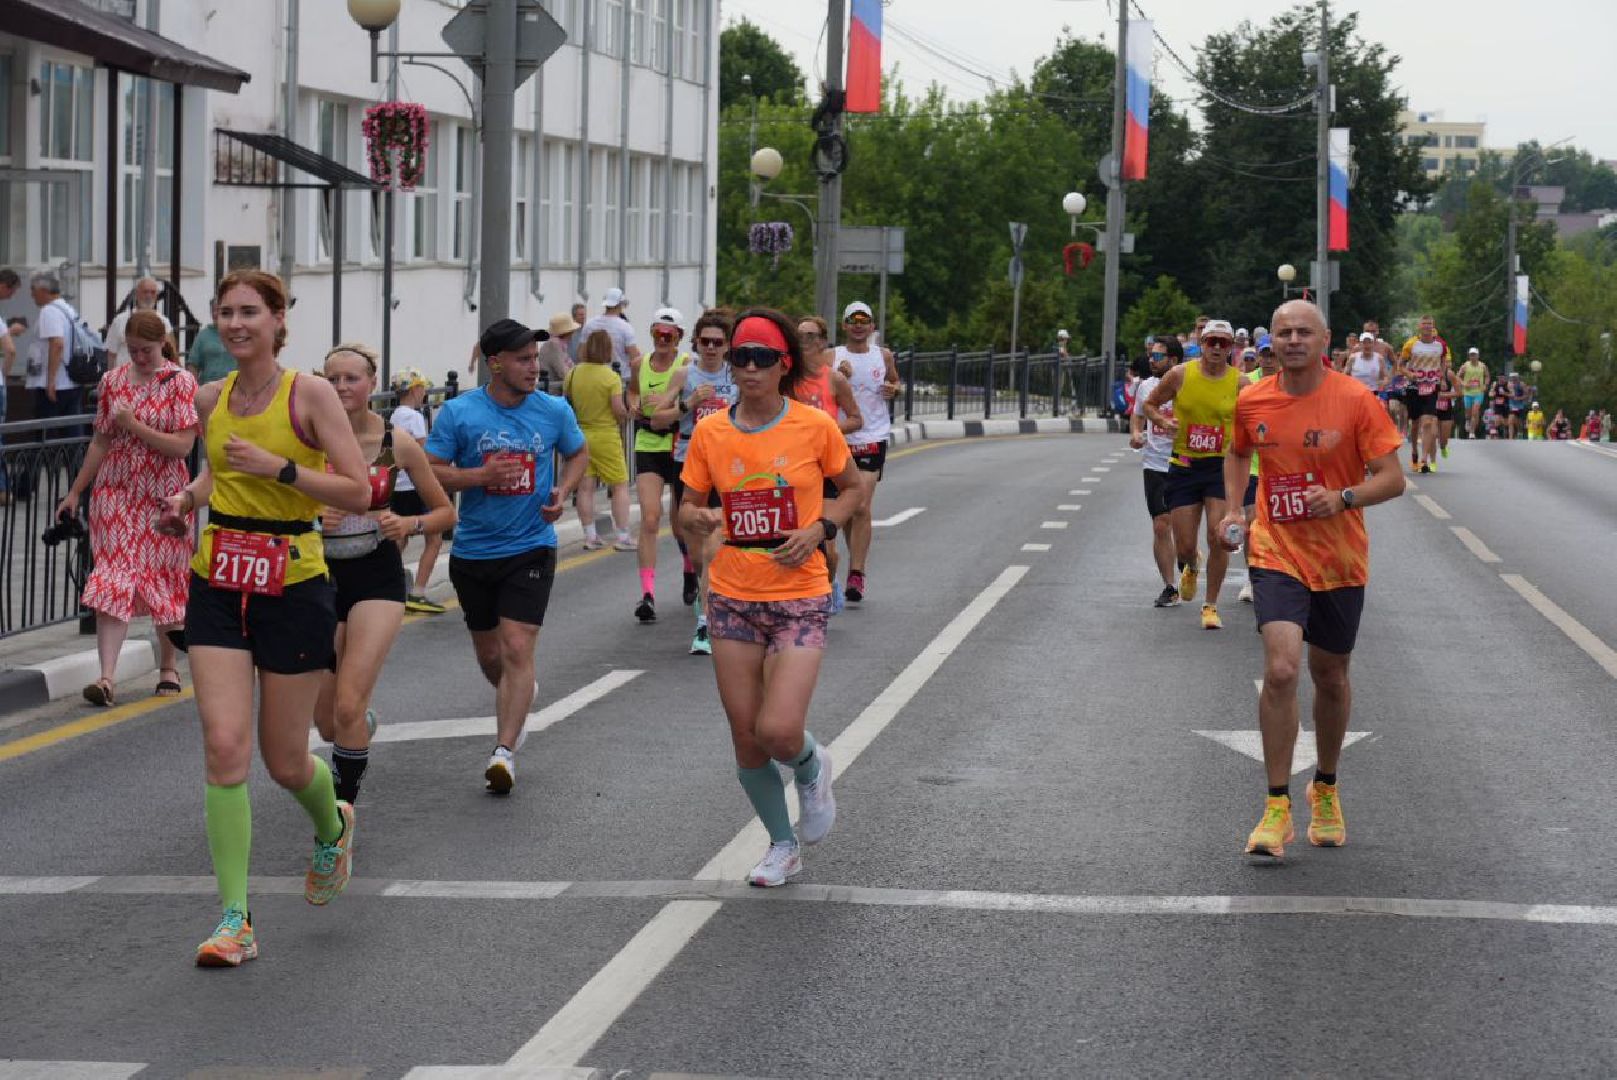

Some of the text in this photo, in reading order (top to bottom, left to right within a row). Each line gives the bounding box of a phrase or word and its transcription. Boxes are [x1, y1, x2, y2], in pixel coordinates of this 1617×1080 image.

[1189, 433, 1217, 449] 2043
[731, 506, 781, 536] 2057
[215, 551, 271, 588] 2179
